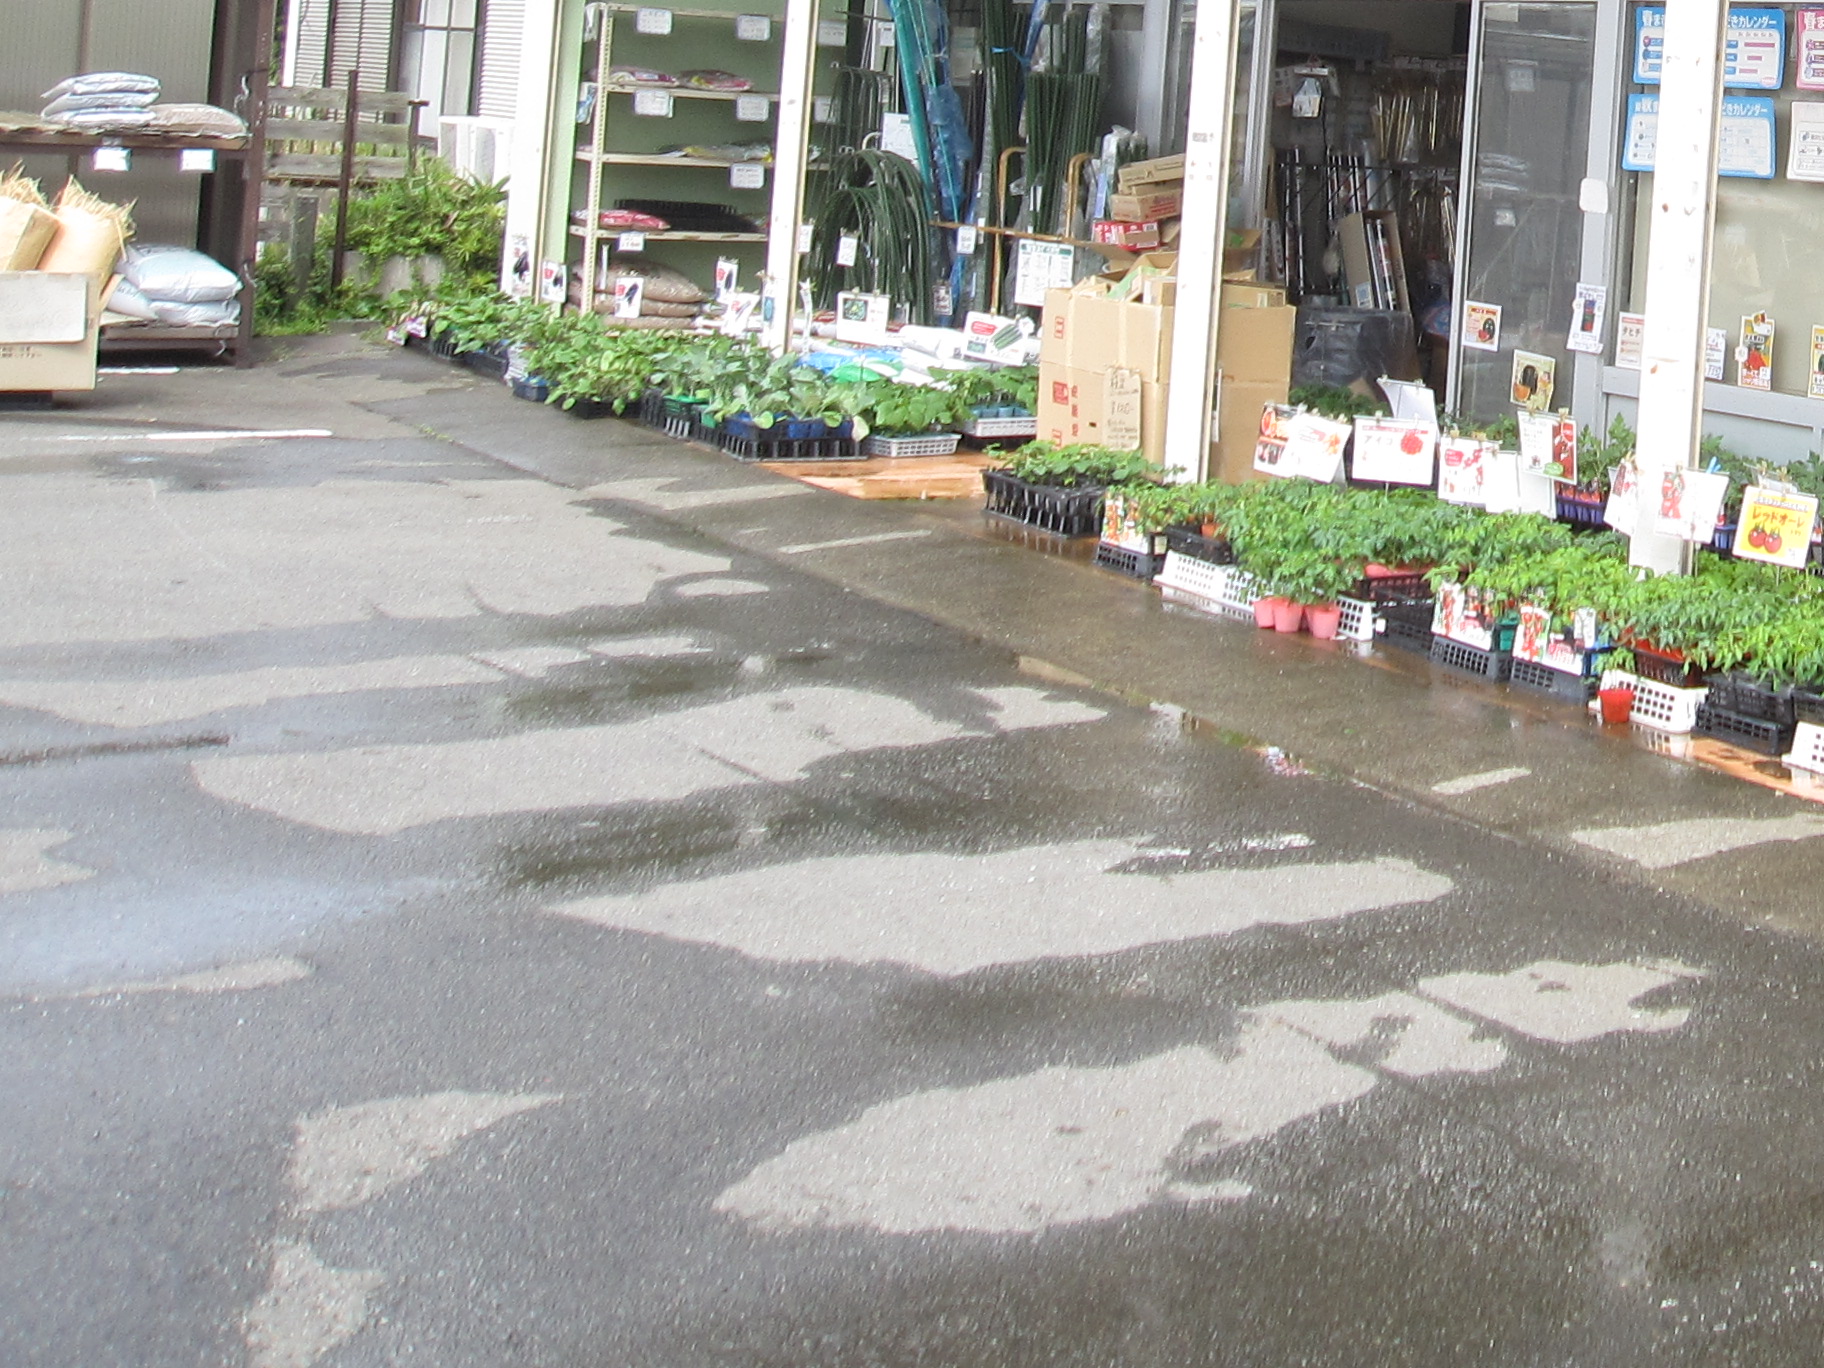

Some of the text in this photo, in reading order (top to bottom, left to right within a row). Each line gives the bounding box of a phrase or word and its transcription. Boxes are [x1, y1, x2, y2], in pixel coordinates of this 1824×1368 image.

[1751, 505, 1806, 529] レッドオーレ
